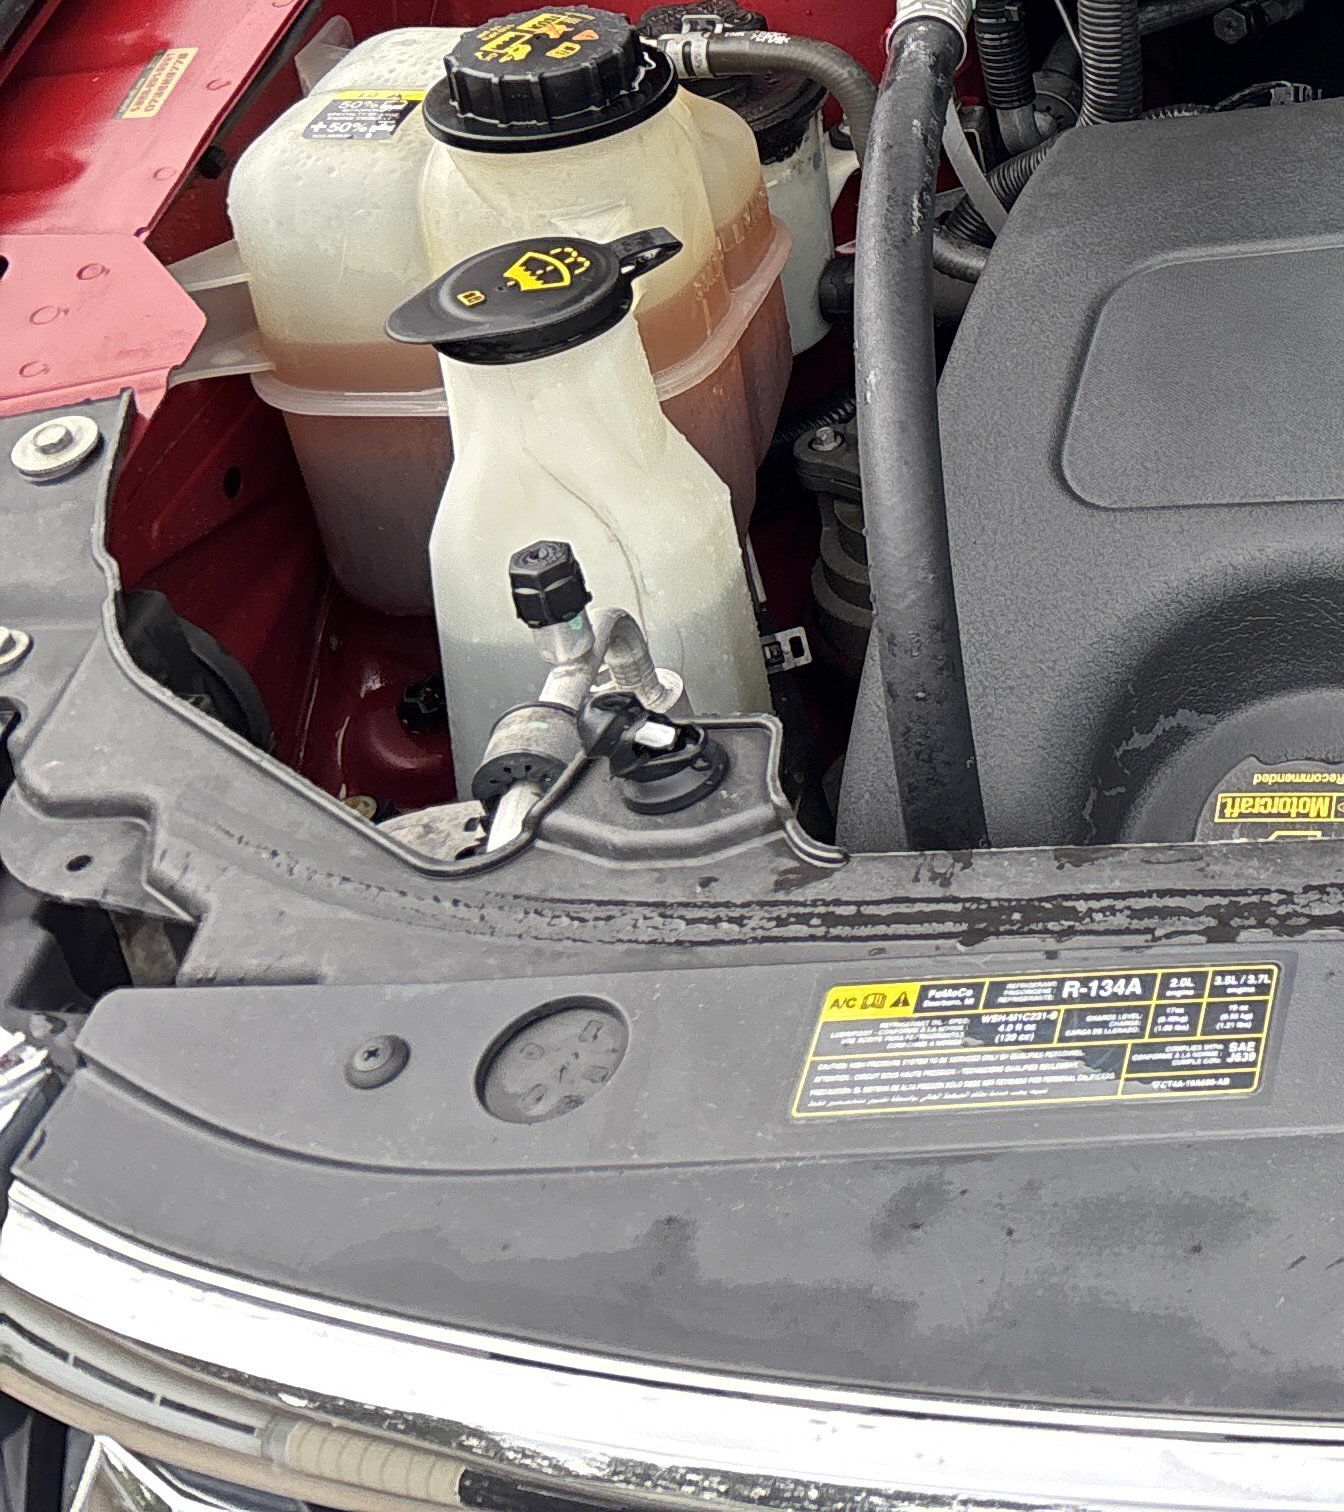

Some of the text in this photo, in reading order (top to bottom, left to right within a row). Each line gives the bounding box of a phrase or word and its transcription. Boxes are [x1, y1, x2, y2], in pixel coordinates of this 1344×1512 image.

[1222, 796, 1332, 819] Motorcraft
[1062, 977, 1142, 999] R-134A
[829, 996, 857, 1009] A/C
[1228, 1041, 1256, 1053] SAE
